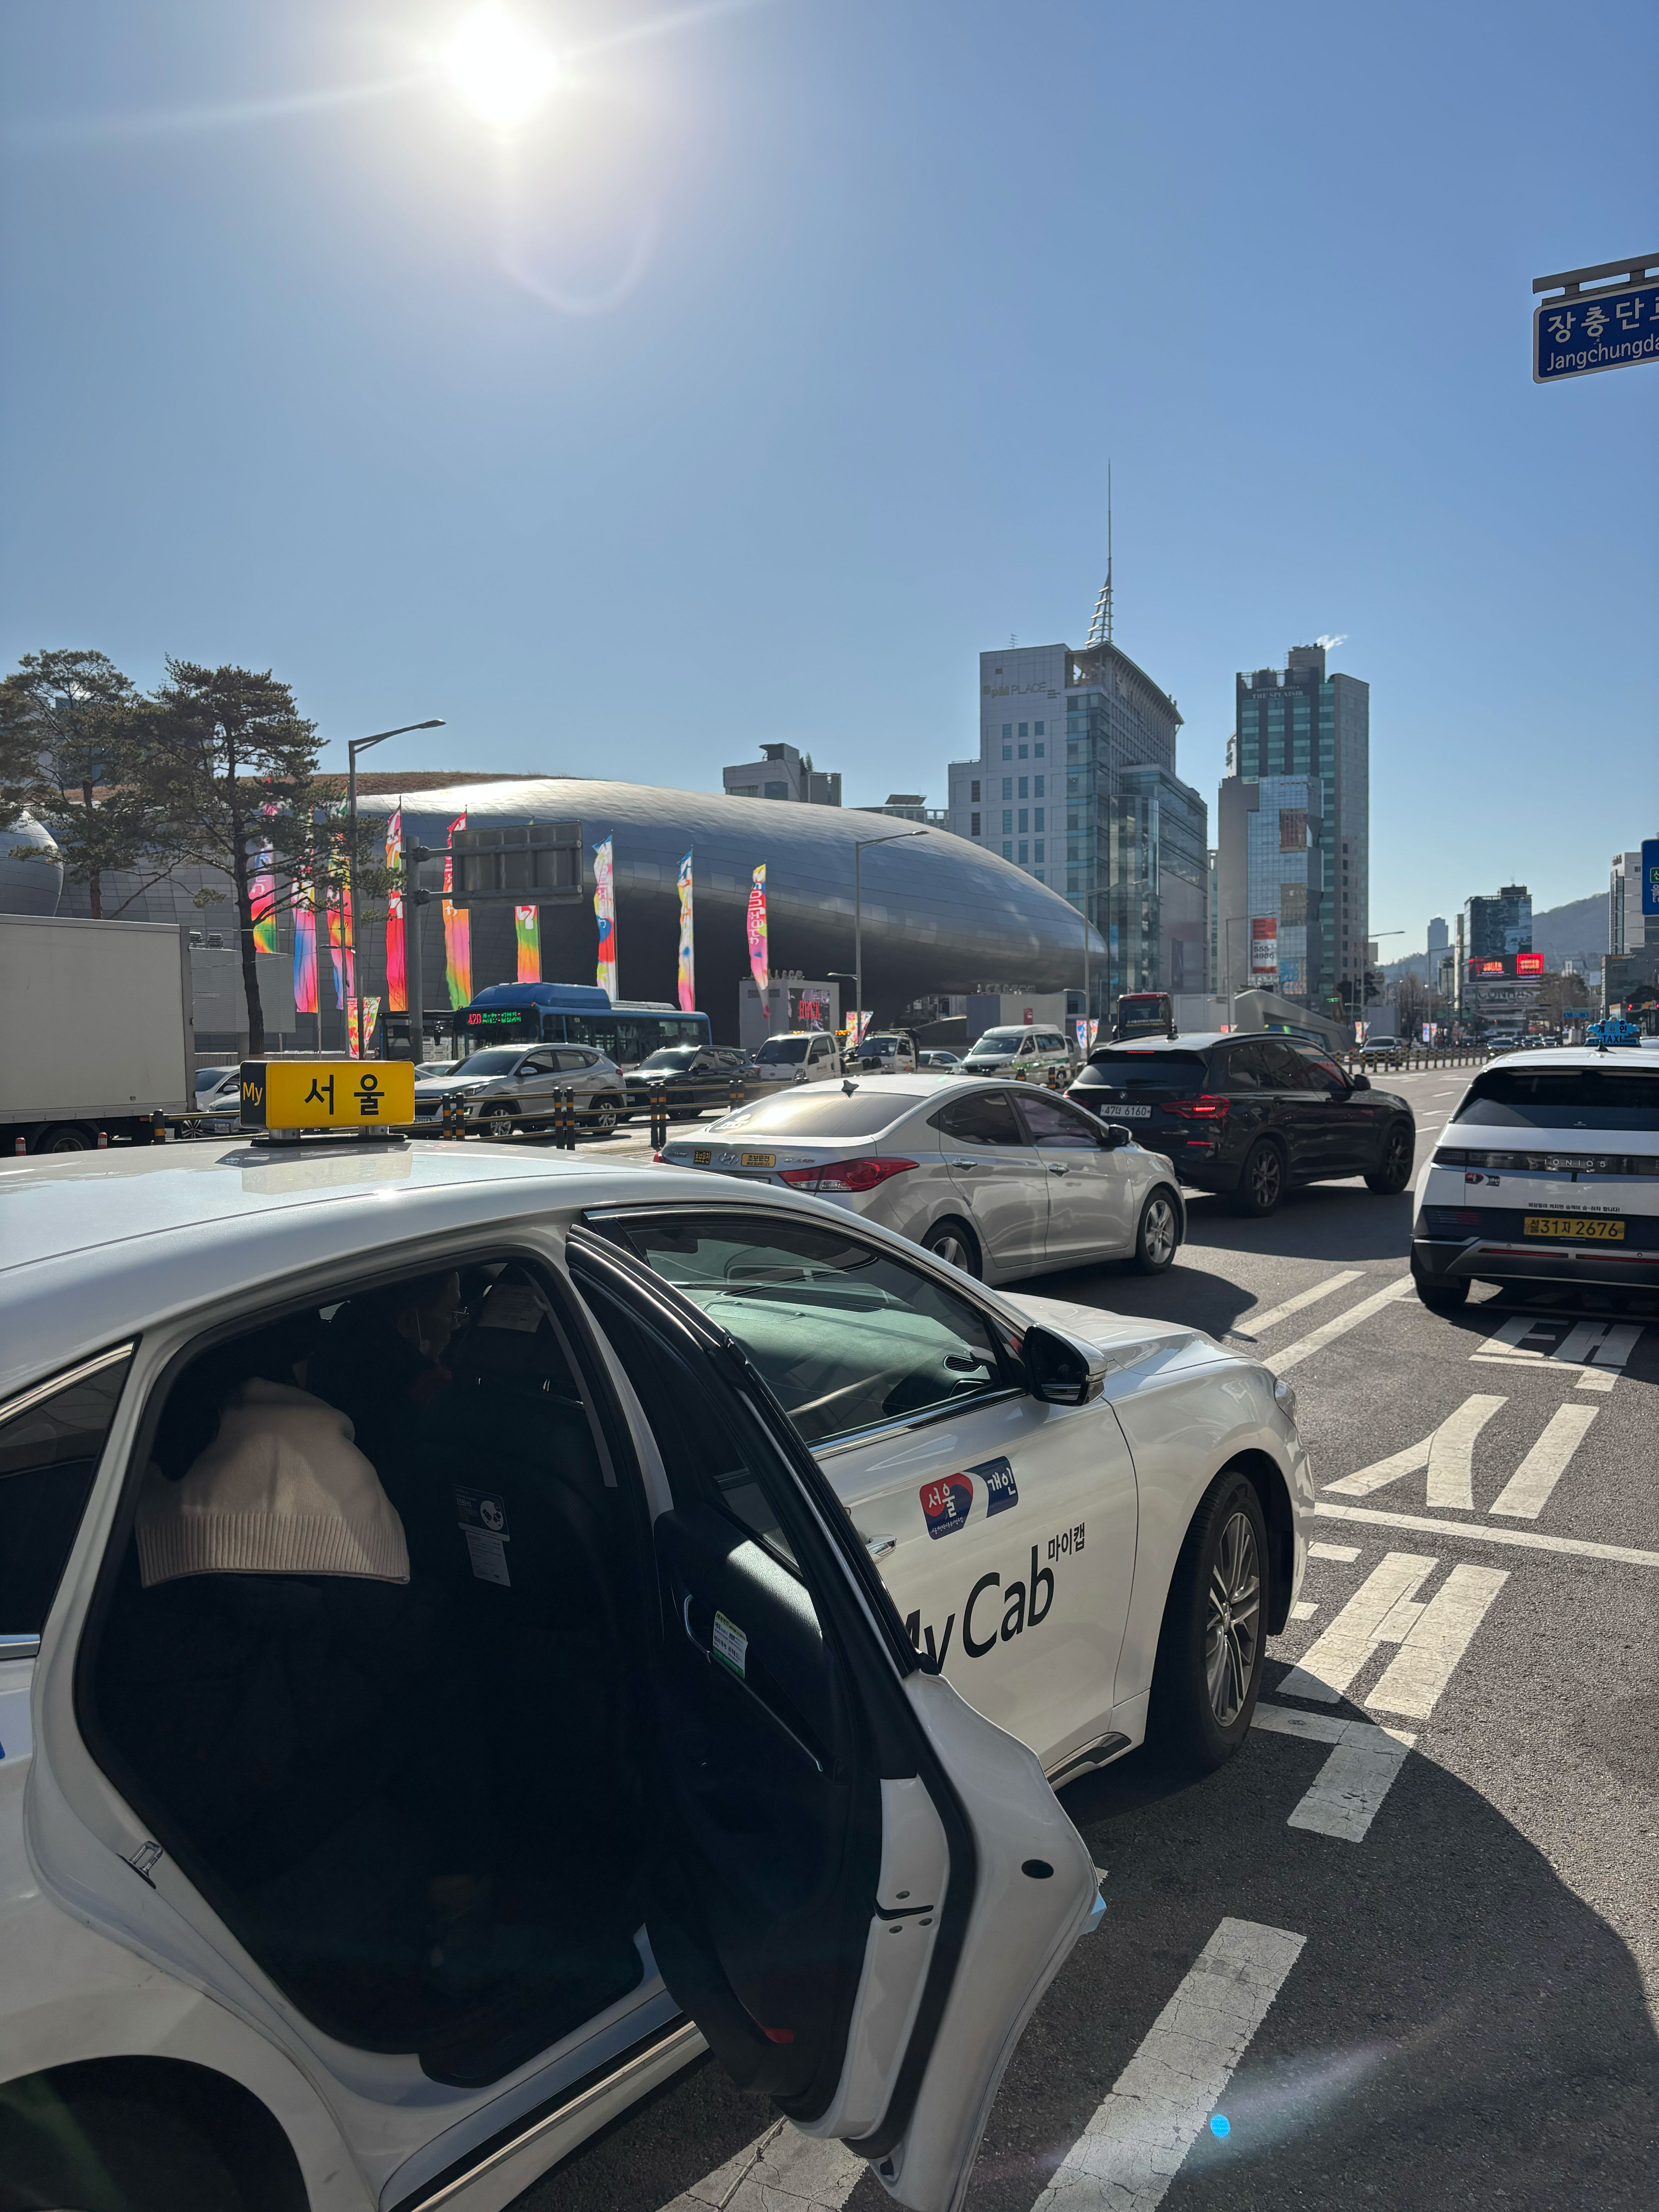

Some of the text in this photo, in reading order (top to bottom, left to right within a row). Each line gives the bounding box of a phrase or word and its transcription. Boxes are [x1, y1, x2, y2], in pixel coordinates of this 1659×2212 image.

[1010, 682, 1047, 695] PLACE
[468, 1013, 482, 1025] 420
[799, 1000, 821, 1020] ROCK
[1602, 1035, 1622, 1044] TAXI
[242, 1082, 263, 1107] My
[304, 1073, 385, 1116] 서울
[1125, 1106, 1147, 1116] 6160
[1544, 1158, 1594, 1167] IONIQ
[1576, 1221, 1618, 1237] 2676
[987, 1467, 1016, 1496] 개인
[928, 1483, 958, 1518] 서울
[1048, 1522, 1085, 1562] 마이캡
[963, 1544, 1054, 1658] Cab
